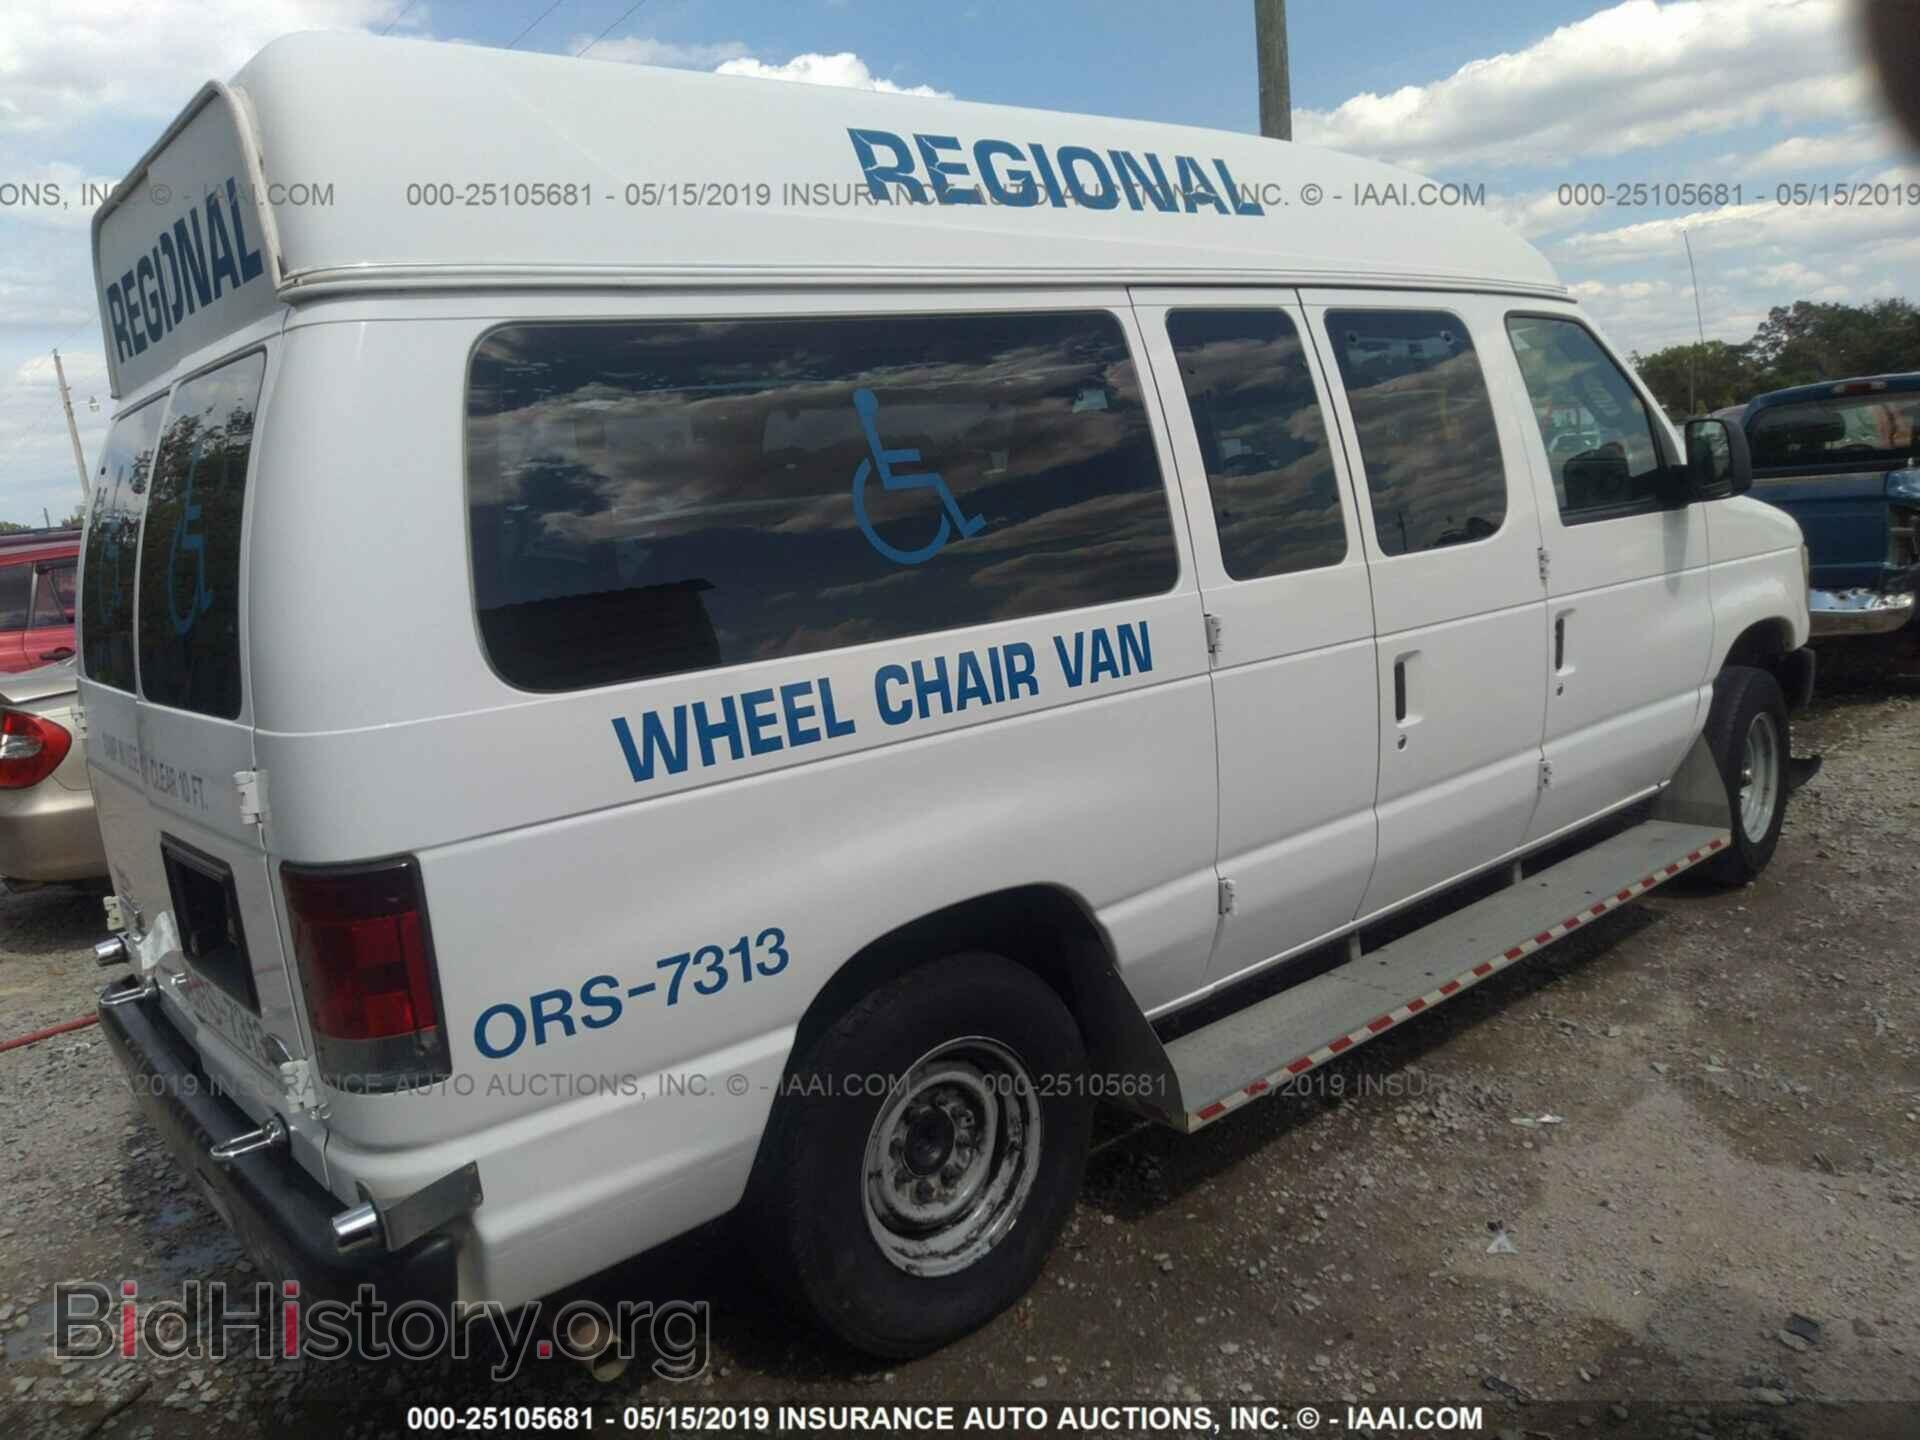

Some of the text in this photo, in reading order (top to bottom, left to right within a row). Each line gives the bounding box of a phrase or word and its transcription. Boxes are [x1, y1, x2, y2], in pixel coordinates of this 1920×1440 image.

[846, 127, 1266, 217] REGIONAL
[611, 620, 1154, 783] WHEEL CHAIR VAN
[473, 926, 790, 1060] ORS-7313
